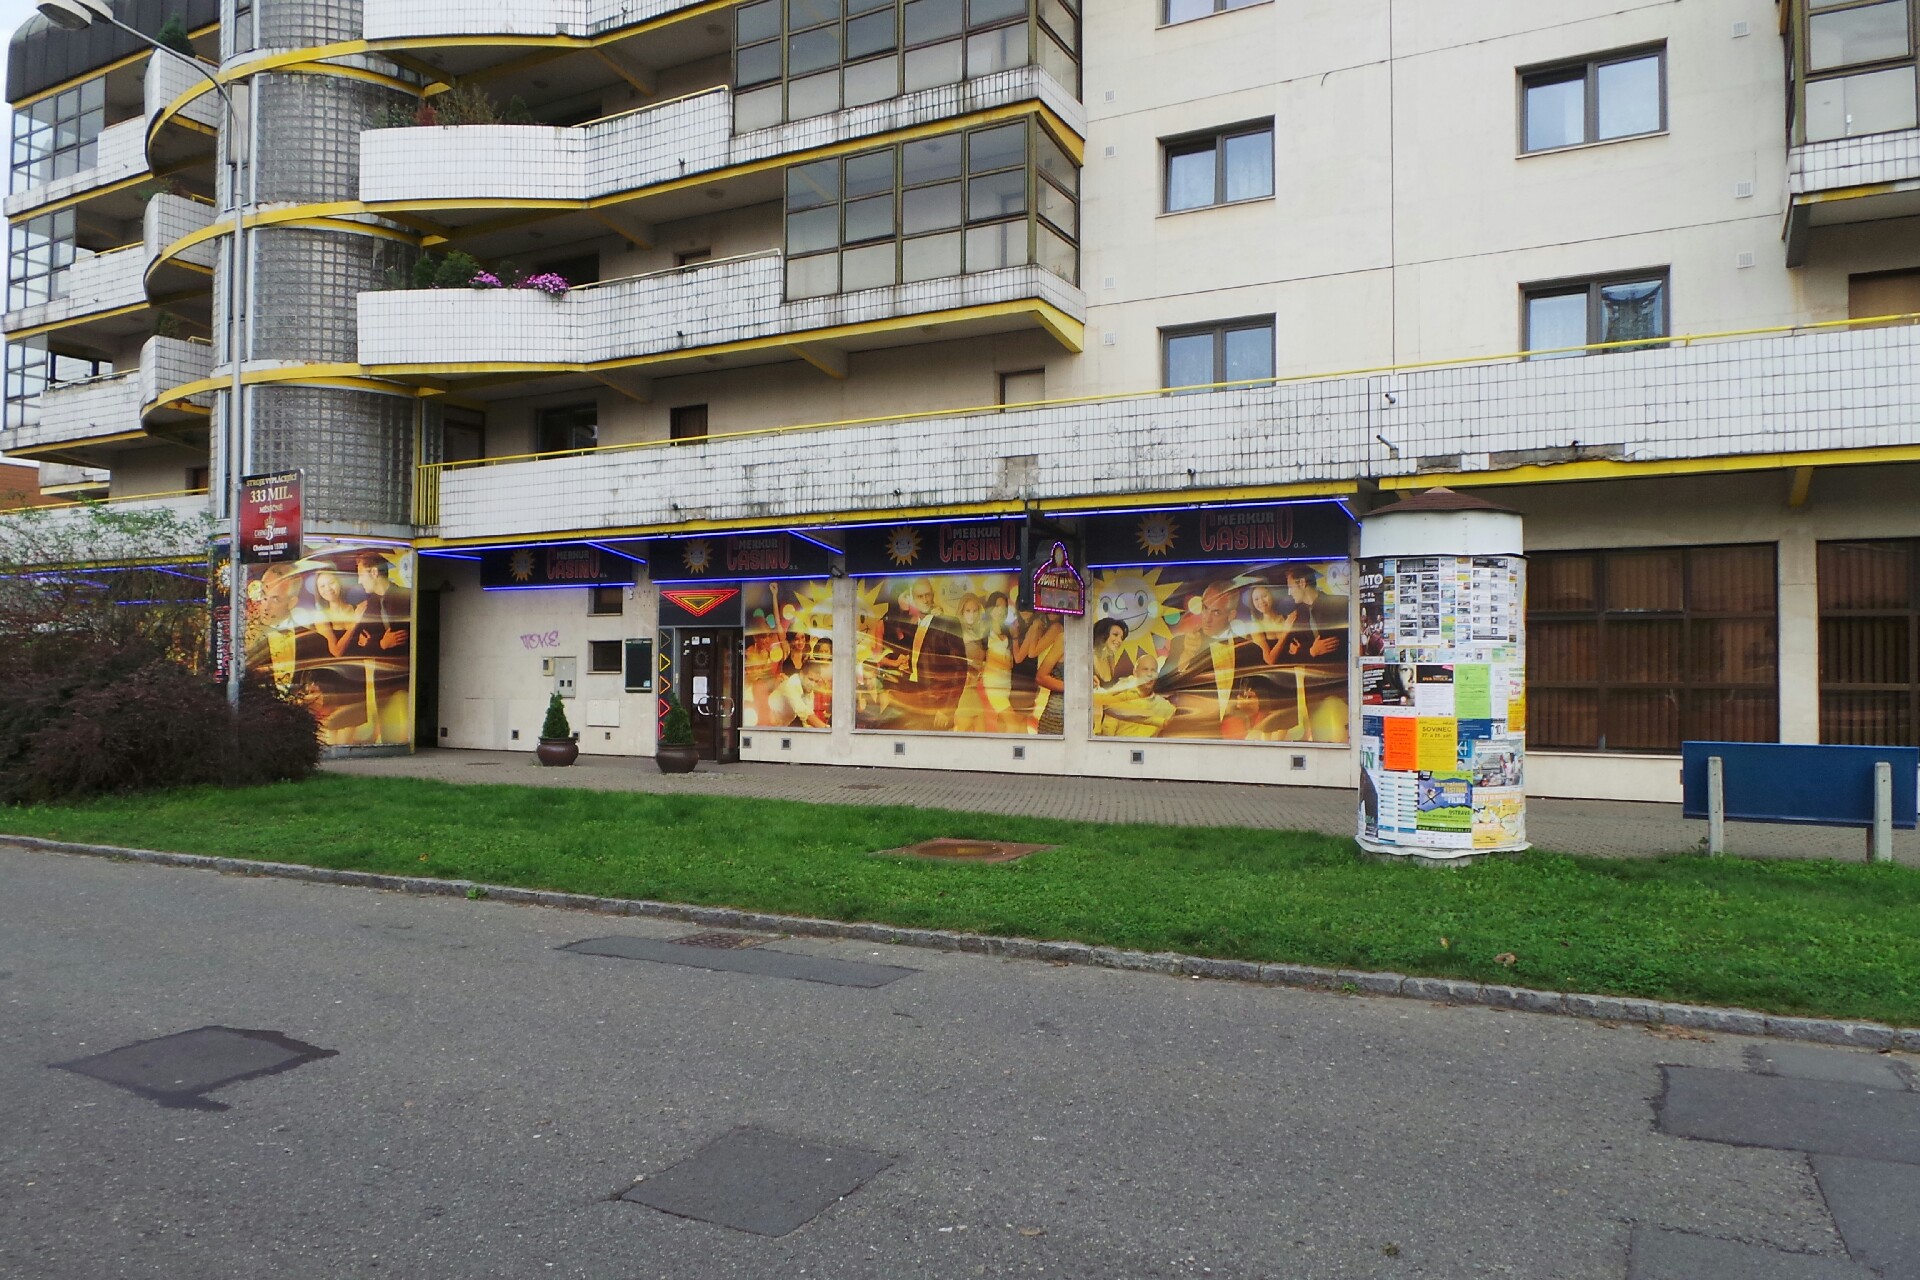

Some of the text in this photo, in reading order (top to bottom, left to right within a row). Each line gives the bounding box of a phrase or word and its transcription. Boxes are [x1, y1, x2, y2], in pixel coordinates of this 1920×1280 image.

[249, 486, 293, 503] 333 MIL.
[1217, 511, 1275, 526] MERKUR
[952, 527, 1001, 539] MERKUR
[1200, 506, 1294, 552] CASINO
[738, 538, 779, 550] MERKUR
[939, 520, 1016, 563] CASINO
[556, 551, 590, 560] MERKUR
[727, 535, 790, 571] CASINO
[547, 549, 600, 580] CASINO
